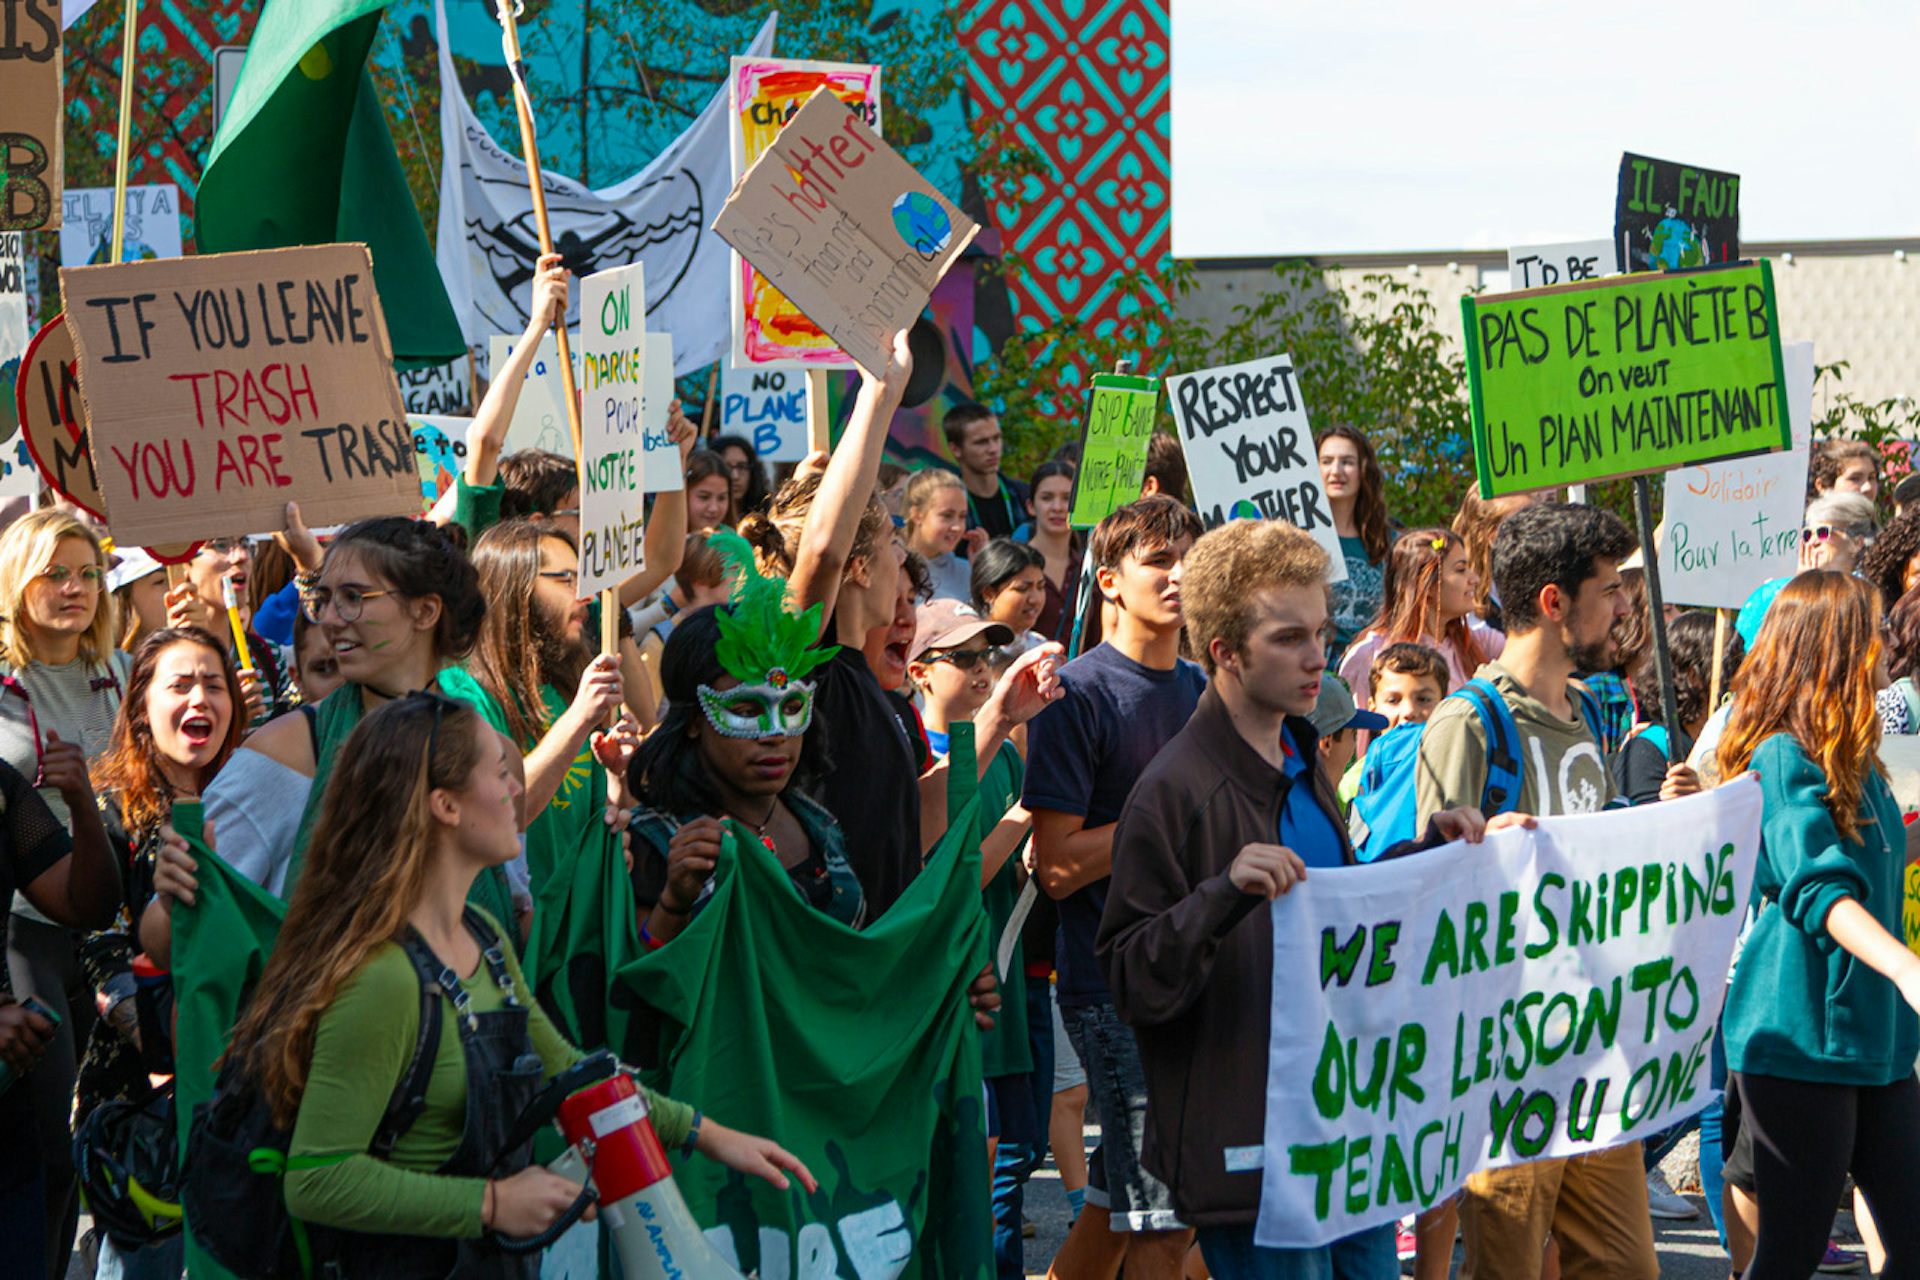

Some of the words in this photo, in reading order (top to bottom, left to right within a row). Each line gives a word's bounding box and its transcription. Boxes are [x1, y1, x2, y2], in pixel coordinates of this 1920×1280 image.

[771, 113, 876, 225] hotter
[1627, 159, 1663, 215] IL
[1678, 172, 1741, 220] FAUT
[63, 193, 103, 224] IL
[151, 188, 172, 216] A
[880, 223, 945, 306] normal
[1566, 256, 1599, 282] BE
[86, 293, 156, 364] IF
[174, 288, 251, 351] YOU
[258, 274, 369, 347] LEAVE
[601, 283, 630, 336] ON
[1479, 308, 1550, 370] PAS
[1564, 300, 1601, 360] DE
[1614, 279, 1738, 354] PLANÈTE
[1744, 284, 1769, 340] B
[166, 363, 319, 429] TRASH
[752, 371, 787, 392] NO
[1177, 365, 1298, 441] RESPECT
[605, 396, 639, 435] POUR
[753, 423, 783, 456] B
[1487, 421, 1528, 478] Un
[1611, 381, 1778, 455] MAINTENANT
[110, 438, 196, 500] YOU
[214, 432, 293, 493] ARE
[301, 418, 412, 484] TRASH
[585, 449, 637, 495] NOTRE
[1220, 426, 1308, 484] YOUR
[583, 510, 644, 578] PLANÈTE
[1670, 521, 1720, 573] Pour
[1731, 529, 1754, 562] la
[1320, 919, 1401, 991] WE
[1421, 889, 1520, 987] ARE
[1312, 1020, 1427, 1121] OUR
[1452, 974, 1622, 1100] LESSON
[1630, 955, 1701, 1044] TO
[1288, 1111, 1464, 1222] TEACH
[1487, 1078, 1610, 1159] YOU
[1619, 1024, 1714, 1132] ONE
